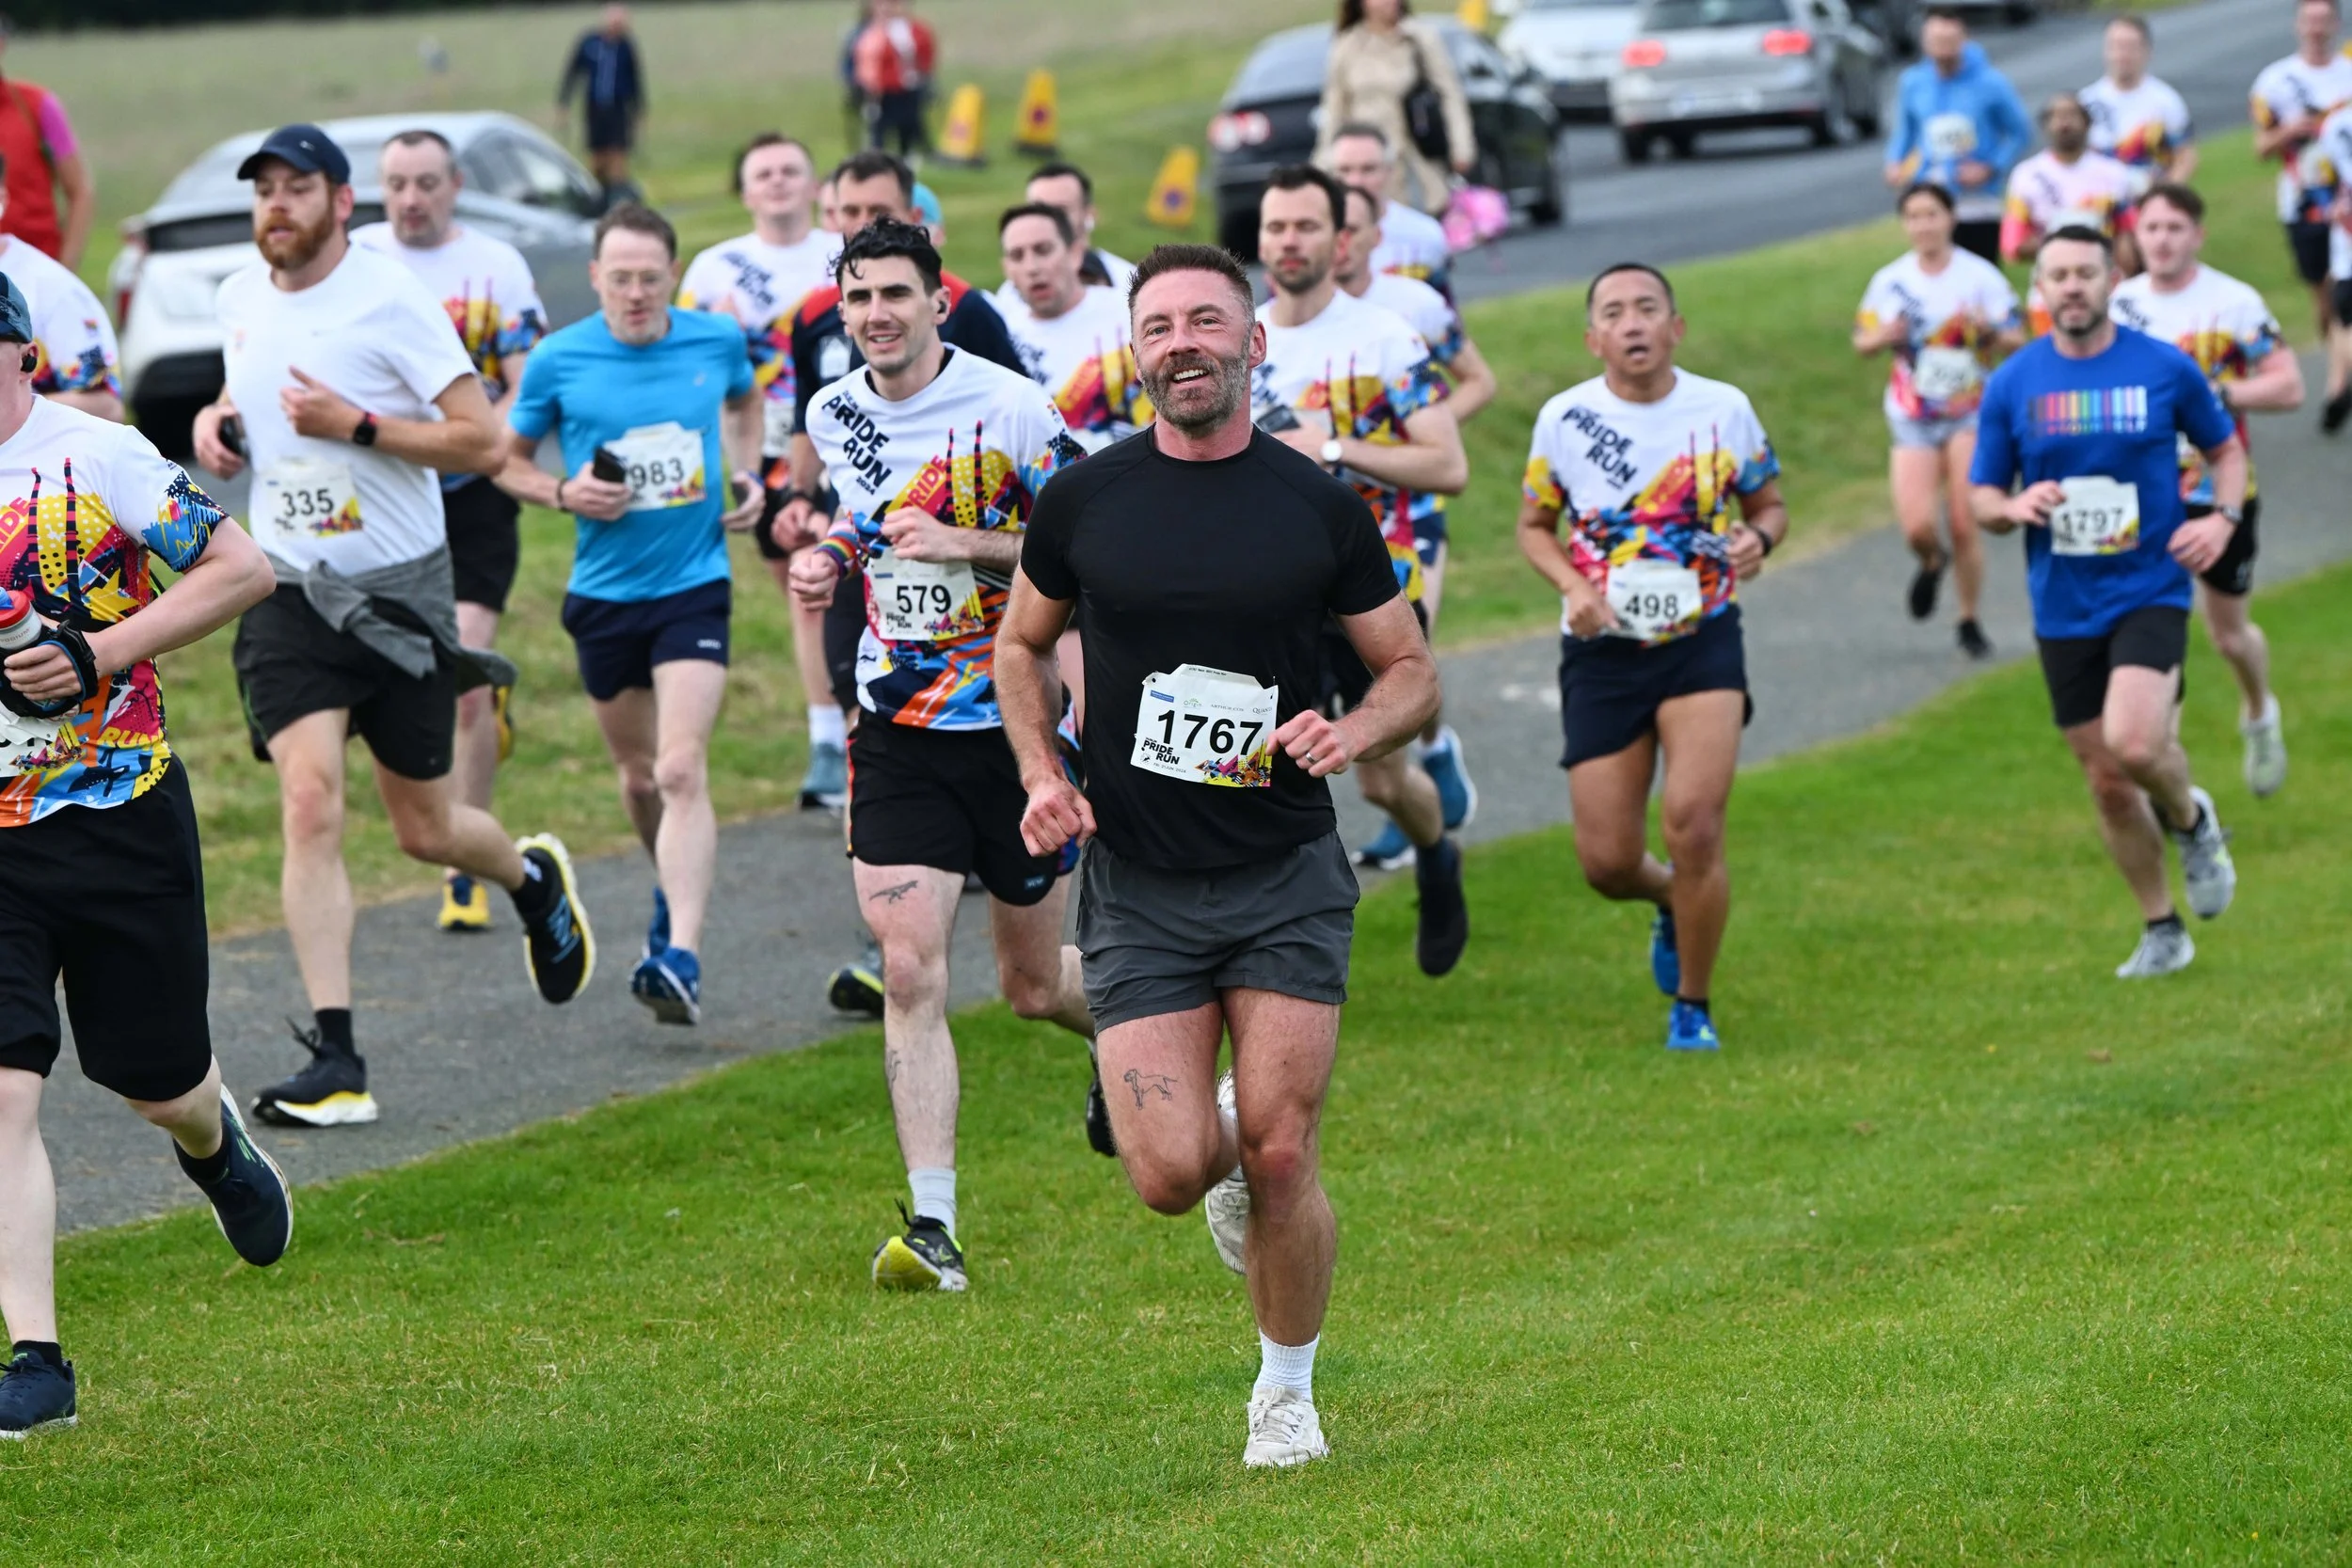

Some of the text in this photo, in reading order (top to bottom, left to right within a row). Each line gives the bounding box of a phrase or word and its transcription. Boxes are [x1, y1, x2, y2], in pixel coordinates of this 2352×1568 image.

[821, 395, 890, 455] PRIDE
[1562, 408, 1633, 455] PRIDE
[629, 457, 684, 489] 983
[843, 436, 892, 488] RUN
[1585, 444, 1639, 483] RUN
[899, 454, 946, 509] RIDE
[282, 488, 334, 516] 335
[2061, 507, 2123, 532] 1797
[897, 584, 951, 614] 579
[1624, 593, 1679, 620] 498
[1143, 739, 1174, 755] PRIDE
[1157, 709, 1263, 755] 1767
[1155, 753, 1180, 765] RUN
